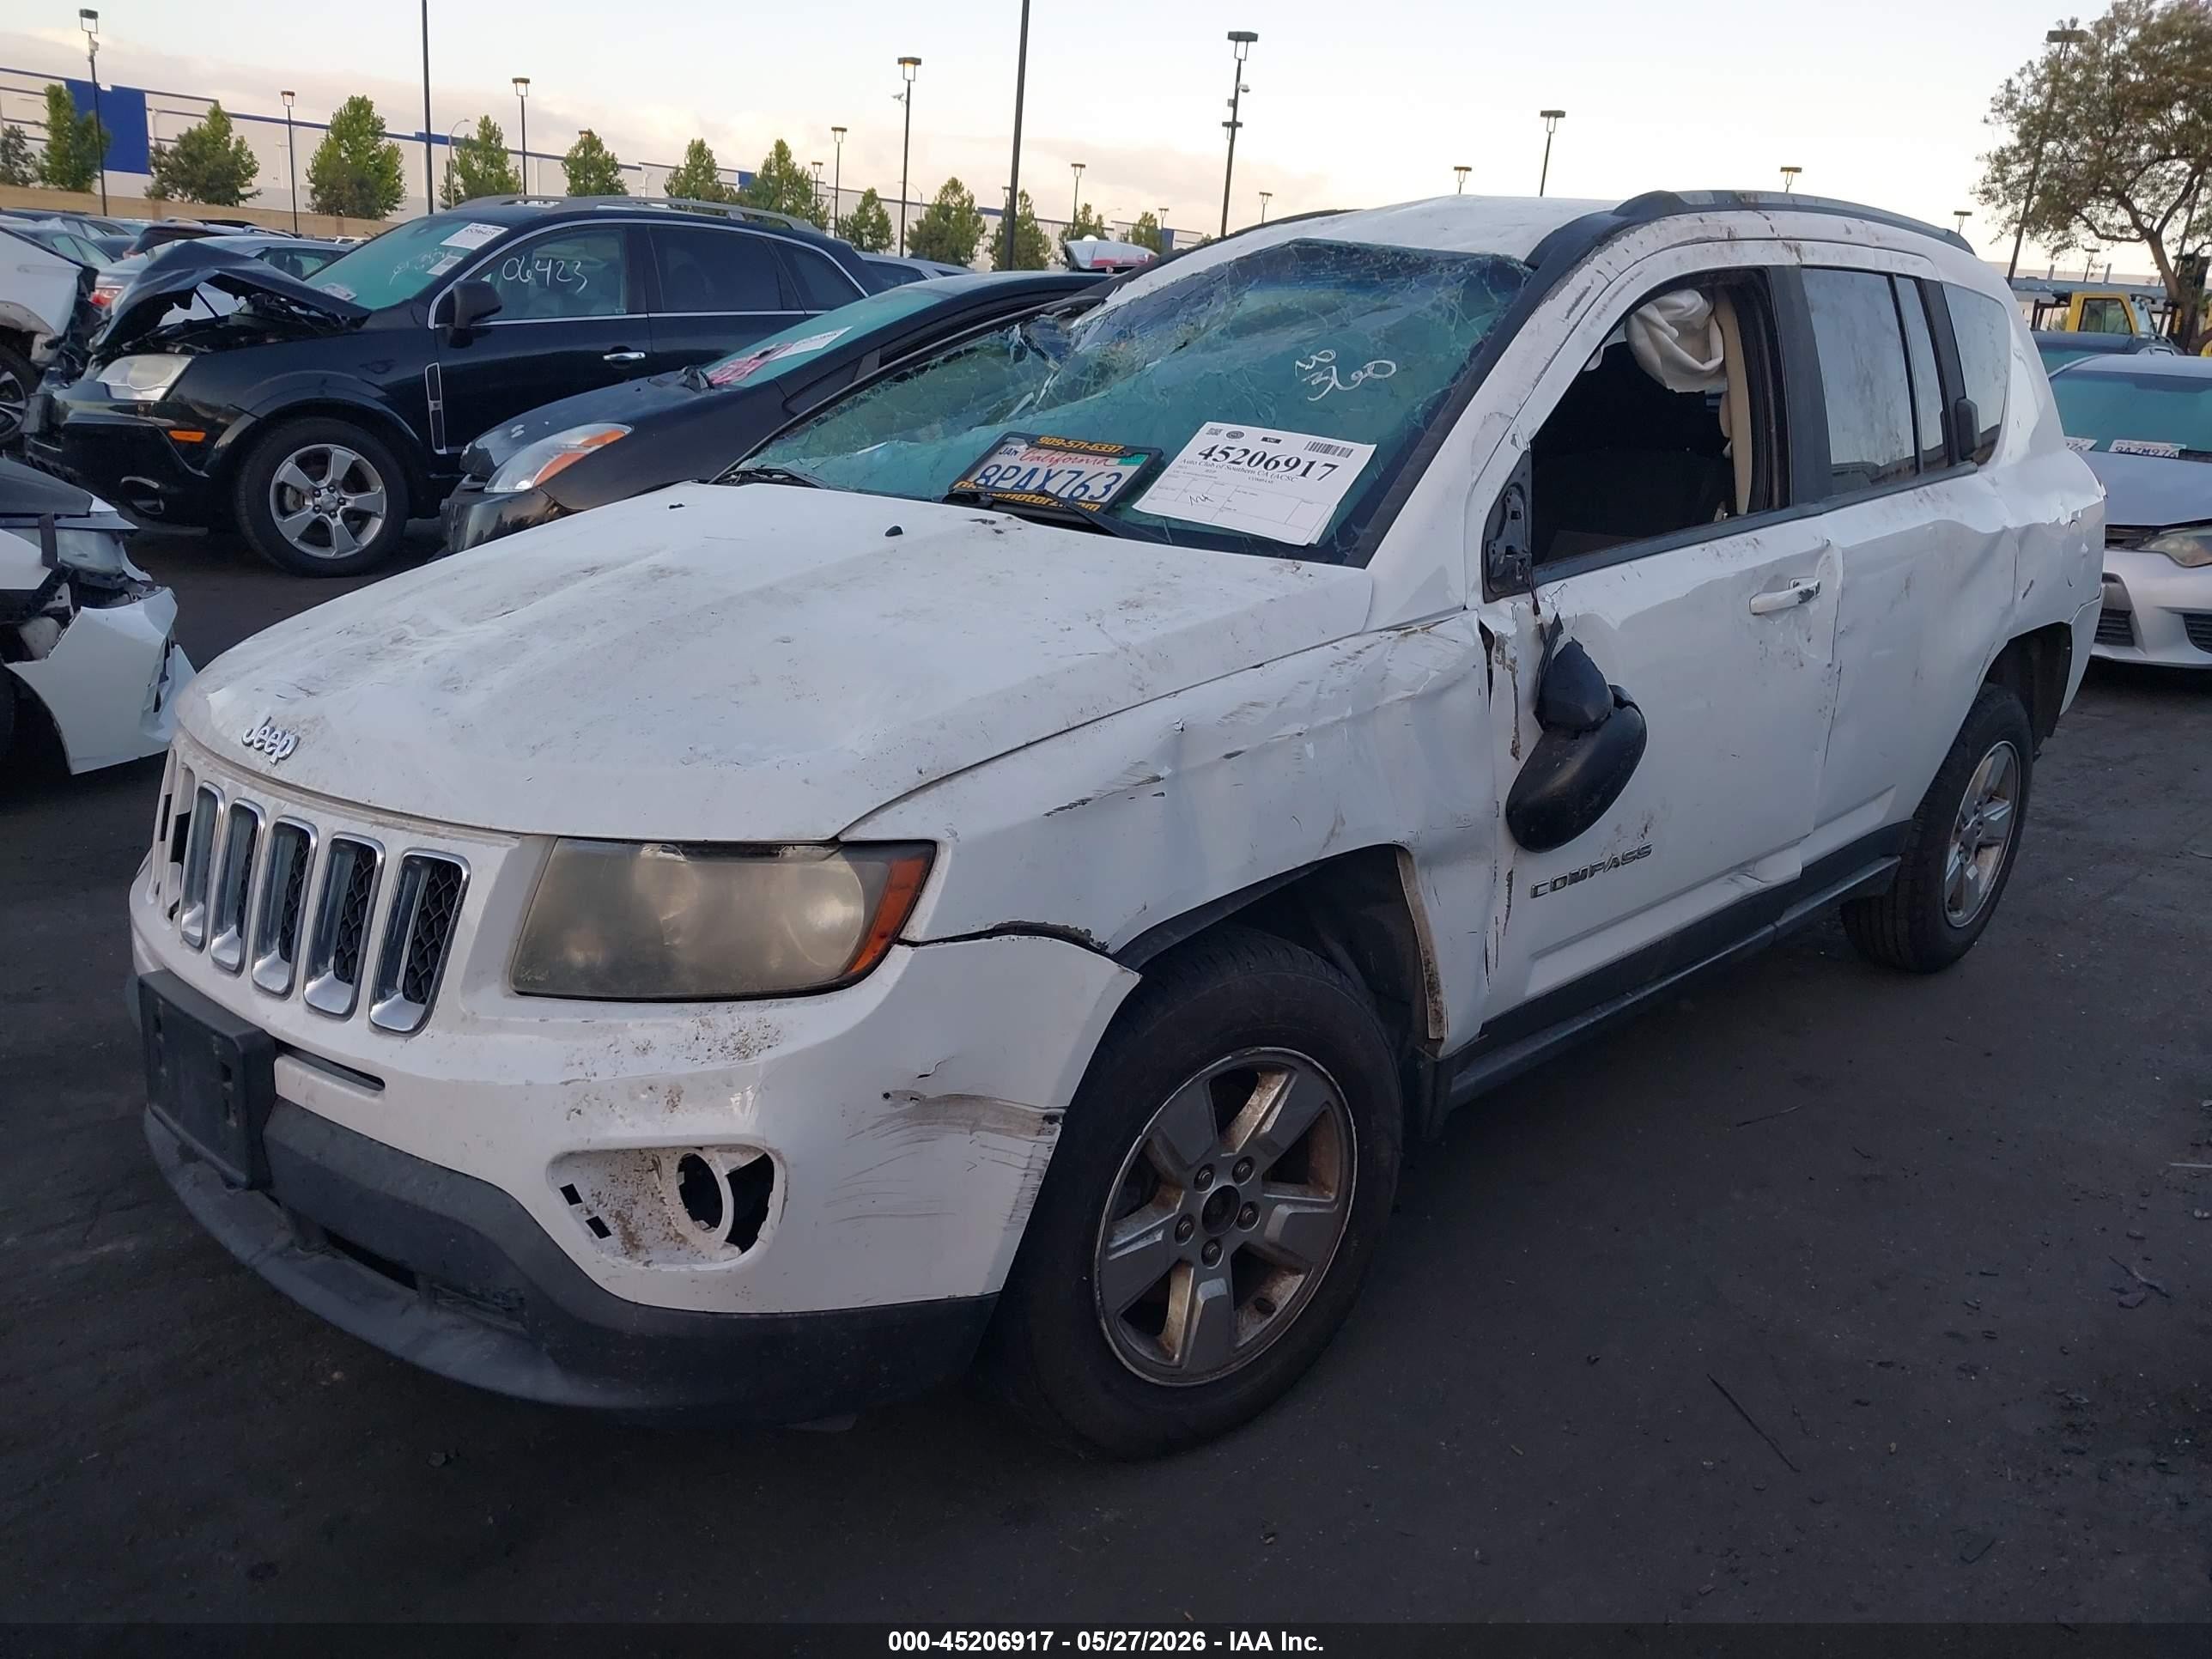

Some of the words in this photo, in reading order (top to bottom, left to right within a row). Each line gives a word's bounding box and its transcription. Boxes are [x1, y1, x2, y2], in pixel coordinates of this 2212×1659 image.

[501, 255, 588, 293] 06423
[999, 447, 1018, 457] JAN
[1018, 447, 1116, 467] California
[1036, 436, 1125, 453] 909-571-6337
[1198, 444, 1340, 482] 45206917
[974, 465, 1123, 501] 8PAX763
[1226, 465, 1256, 475] Southern
[242, 716, 300, 766] Jeep
[1531, 843, 1653, 898] COMPASS
